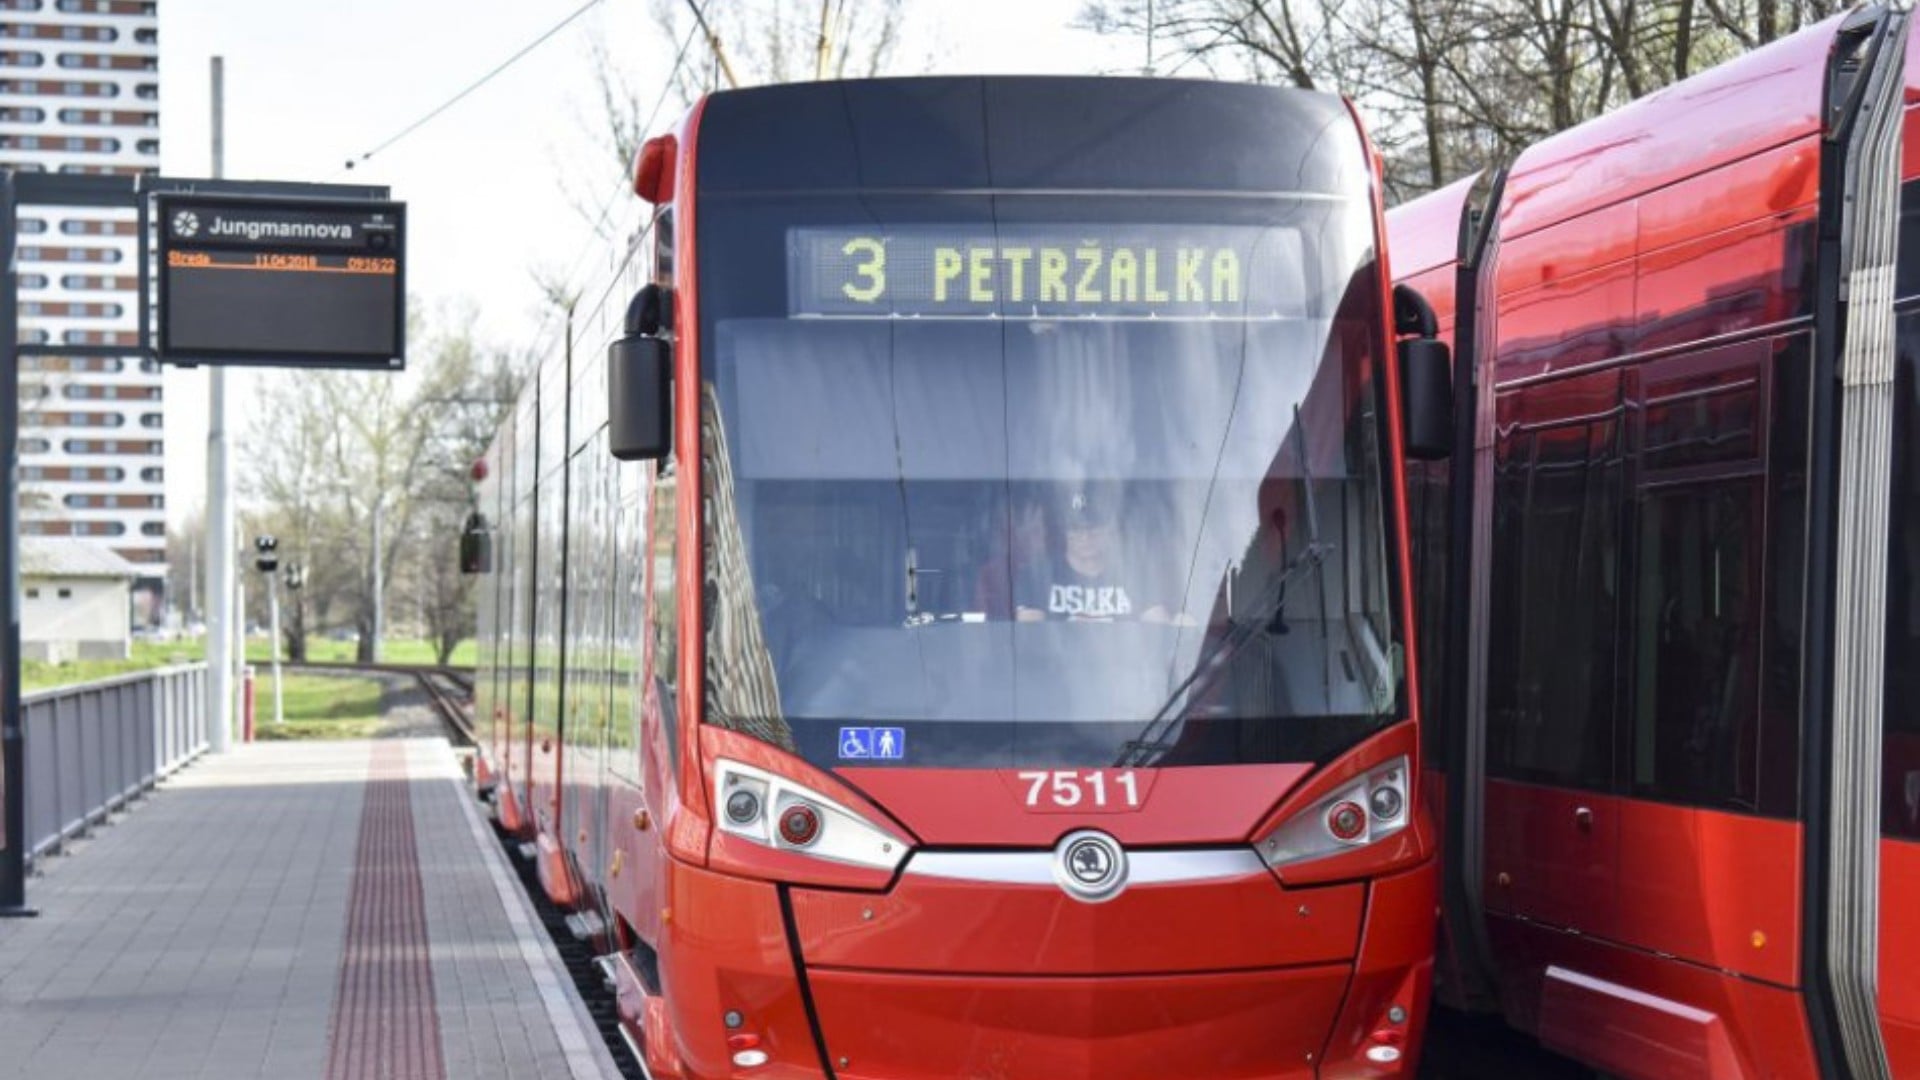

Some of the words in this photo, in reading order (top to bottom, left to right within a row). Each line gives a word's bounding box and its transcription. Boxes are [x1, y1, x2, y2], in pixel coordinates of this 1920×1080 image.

[209, 216, 352, 240] Jungmannova
[842, 238, 886, 302] 3
[934, 239, 1239, 302] PETRŽALKA
[1049, 584, 1132, 615] OSAKA
[1018, 771, 1138, 806] 7511
